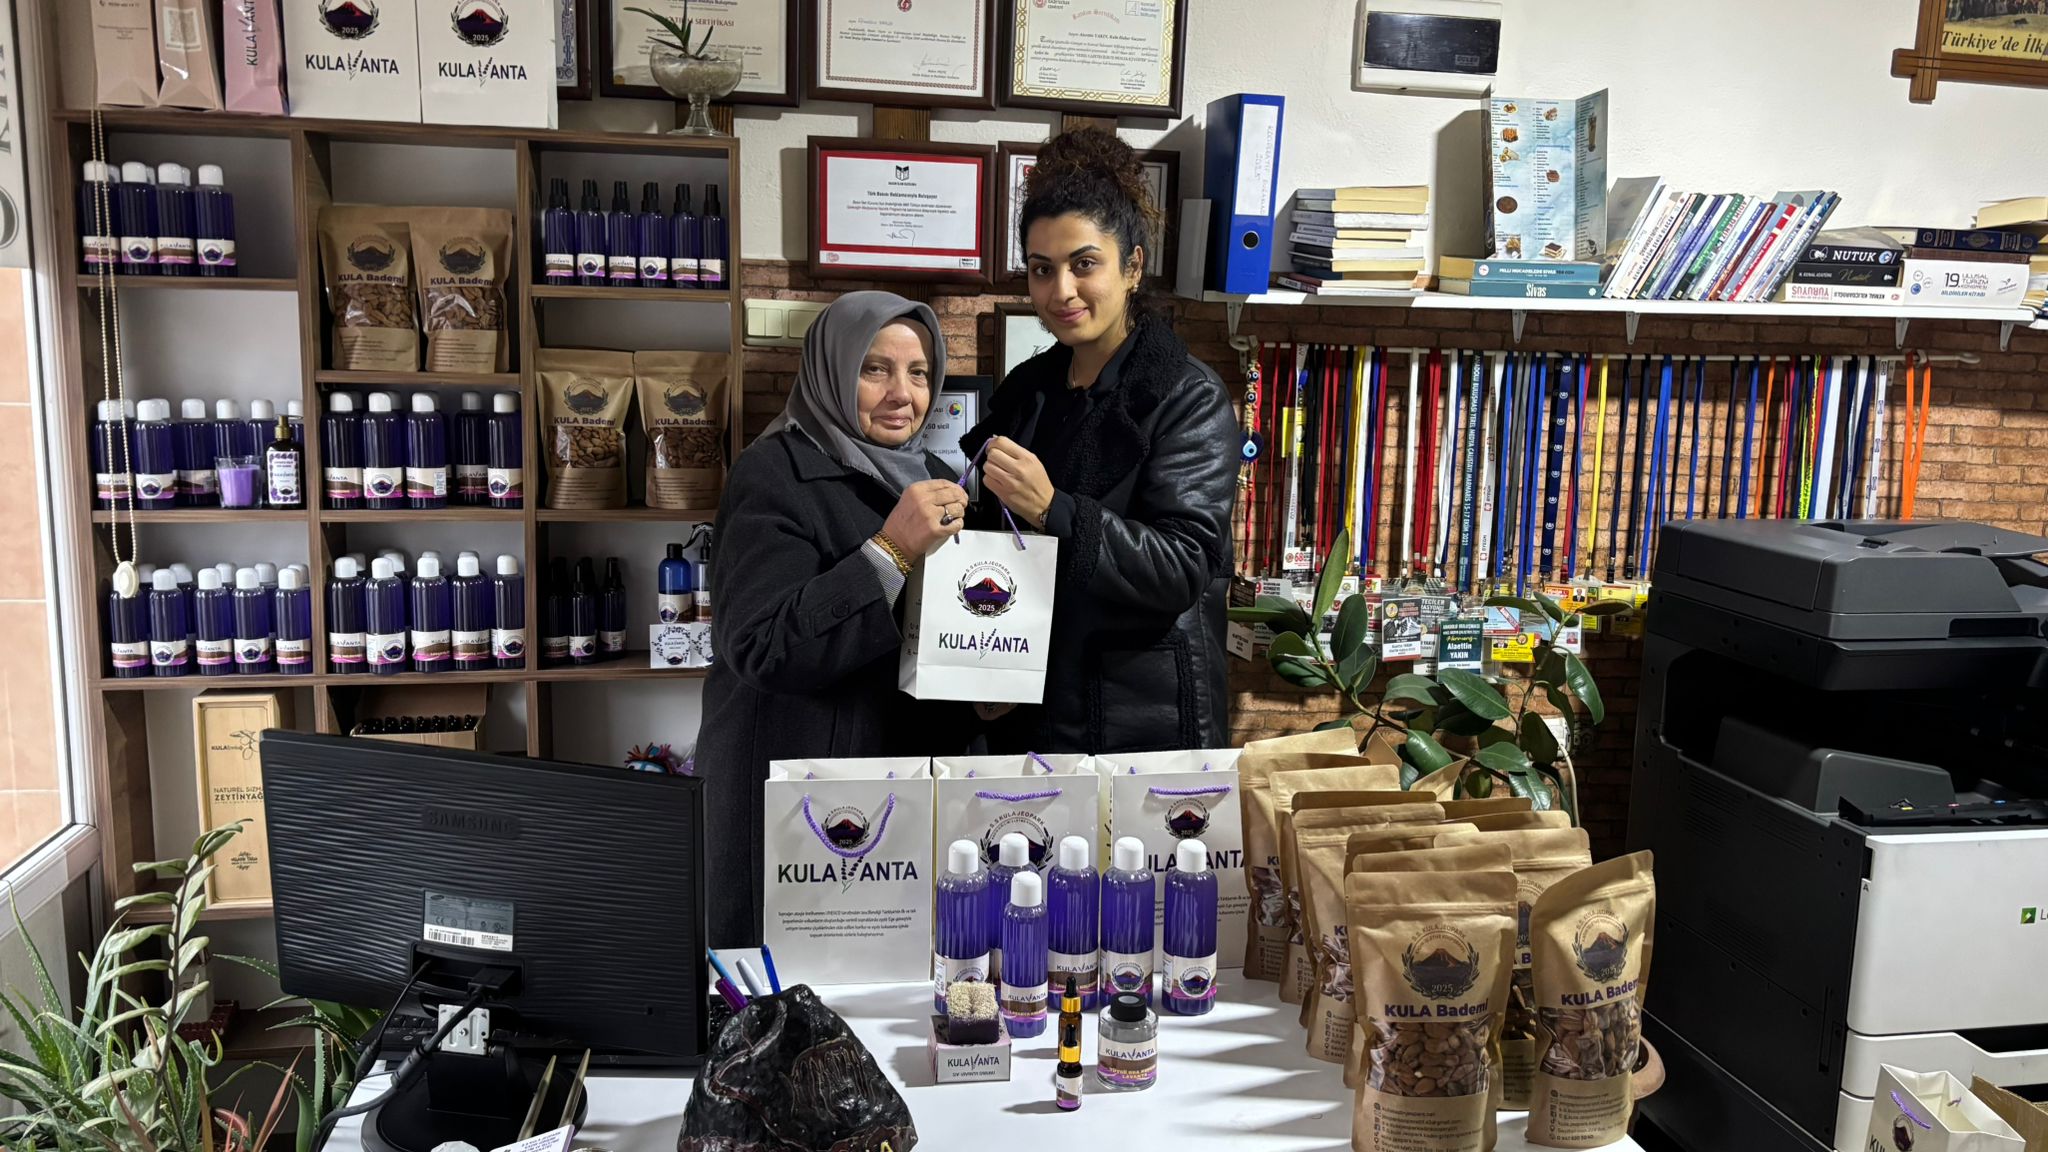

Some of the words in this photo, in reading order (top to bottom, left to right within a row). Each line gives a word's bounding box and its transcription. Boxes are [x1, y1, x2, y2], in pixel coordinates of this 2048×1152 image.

[1942, 31, 2019, 52] Türkiye'de
[2023, 34, 2044, 54] İlk
[1832, 250, 1876, 262] NUTUK
[1526, 283, 1547, 297] Sivas
[978, 604, 996, 612] 2025
[214, 792, 264, 801] ZEYTİNYAĞ
[430, 812, 513, 834] SAMSUNG
[1017, 810, 1044, 826] JEOPARK
[1440, 924, 1466, 939] JEOPARK
[1432, 984, 1454, 992] 2025
[1561, 990, 1604, 1005] KULA
[1384, 1004, 1432, 1017] KULA
[1105, 1048, 1154, 1060] KULAVANTA
